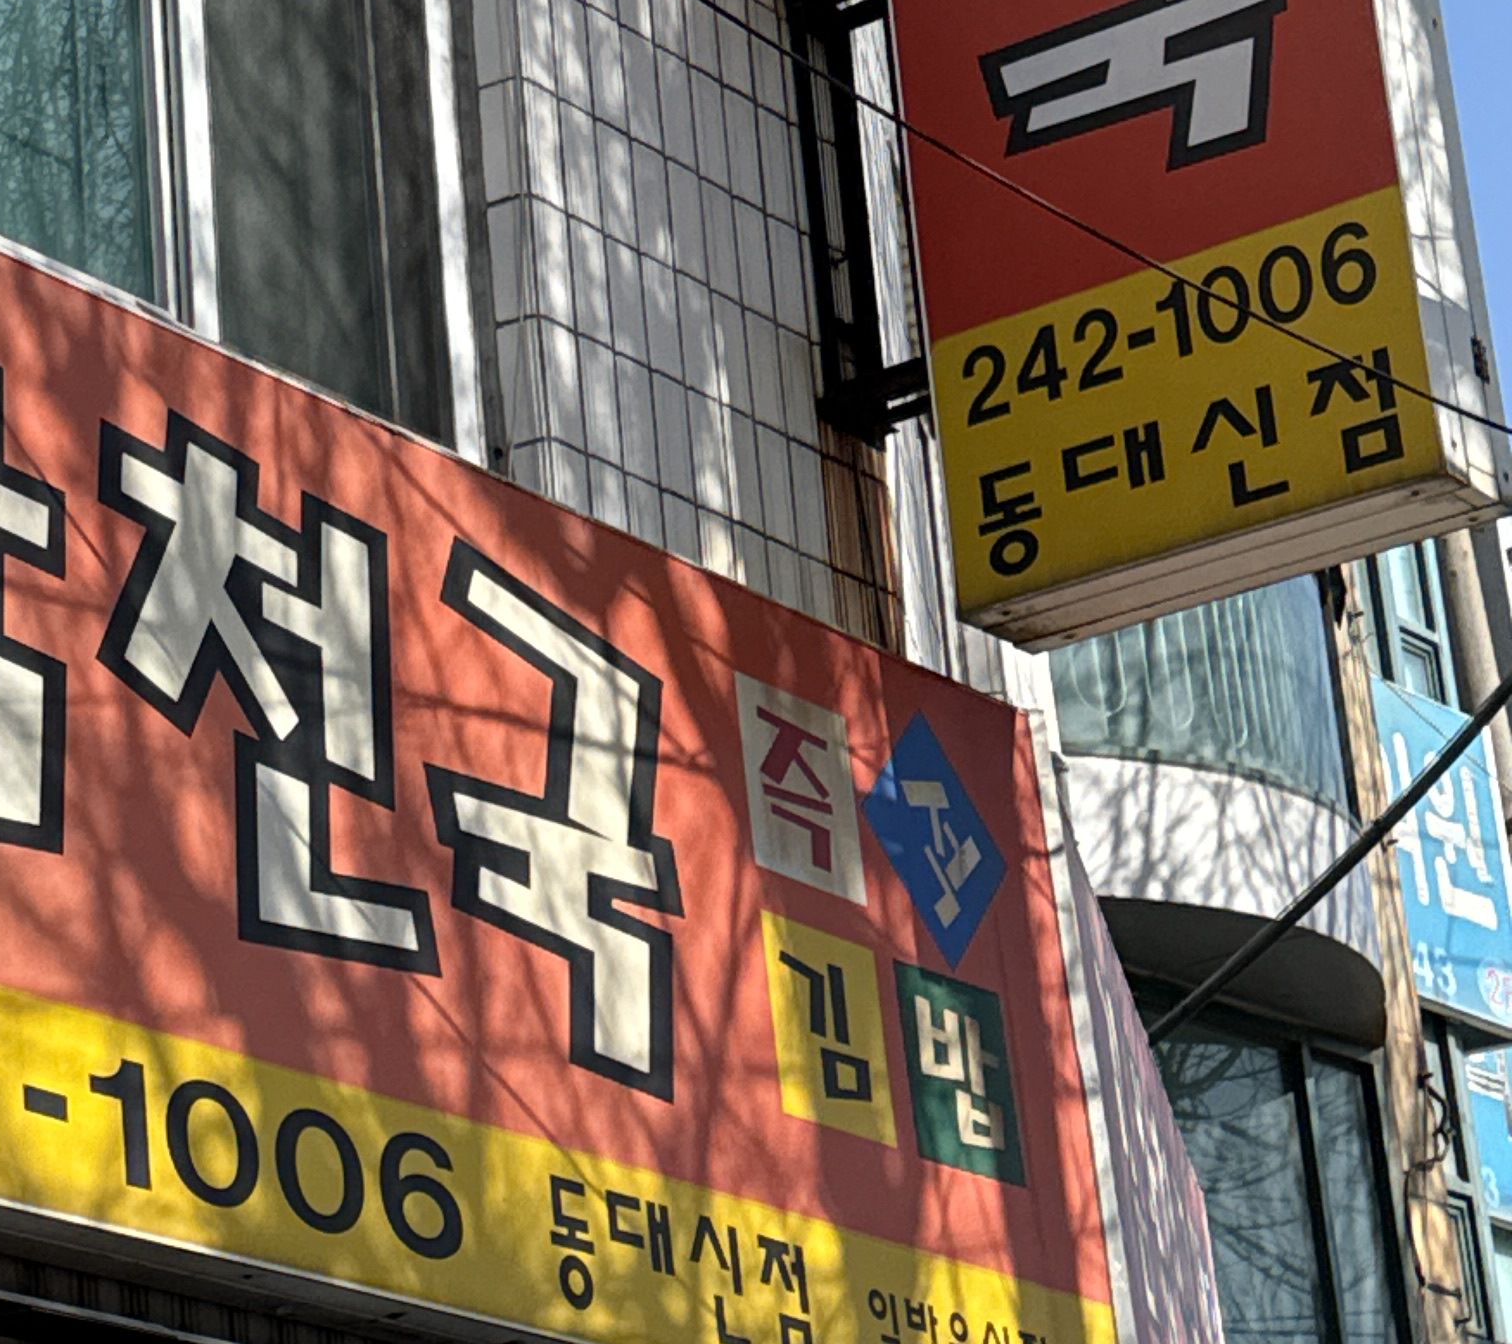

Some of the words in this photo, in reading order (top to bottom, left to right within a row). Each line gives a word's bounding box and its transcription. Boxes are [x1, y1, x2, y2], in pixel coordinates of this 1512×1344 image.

[961, 221, 1377, 427] 242-1006
[978, 347, 1405, 577] 동대신점
[778, 948, 874, 1103] 김
[914, 994, 1006, 1150] 밥
